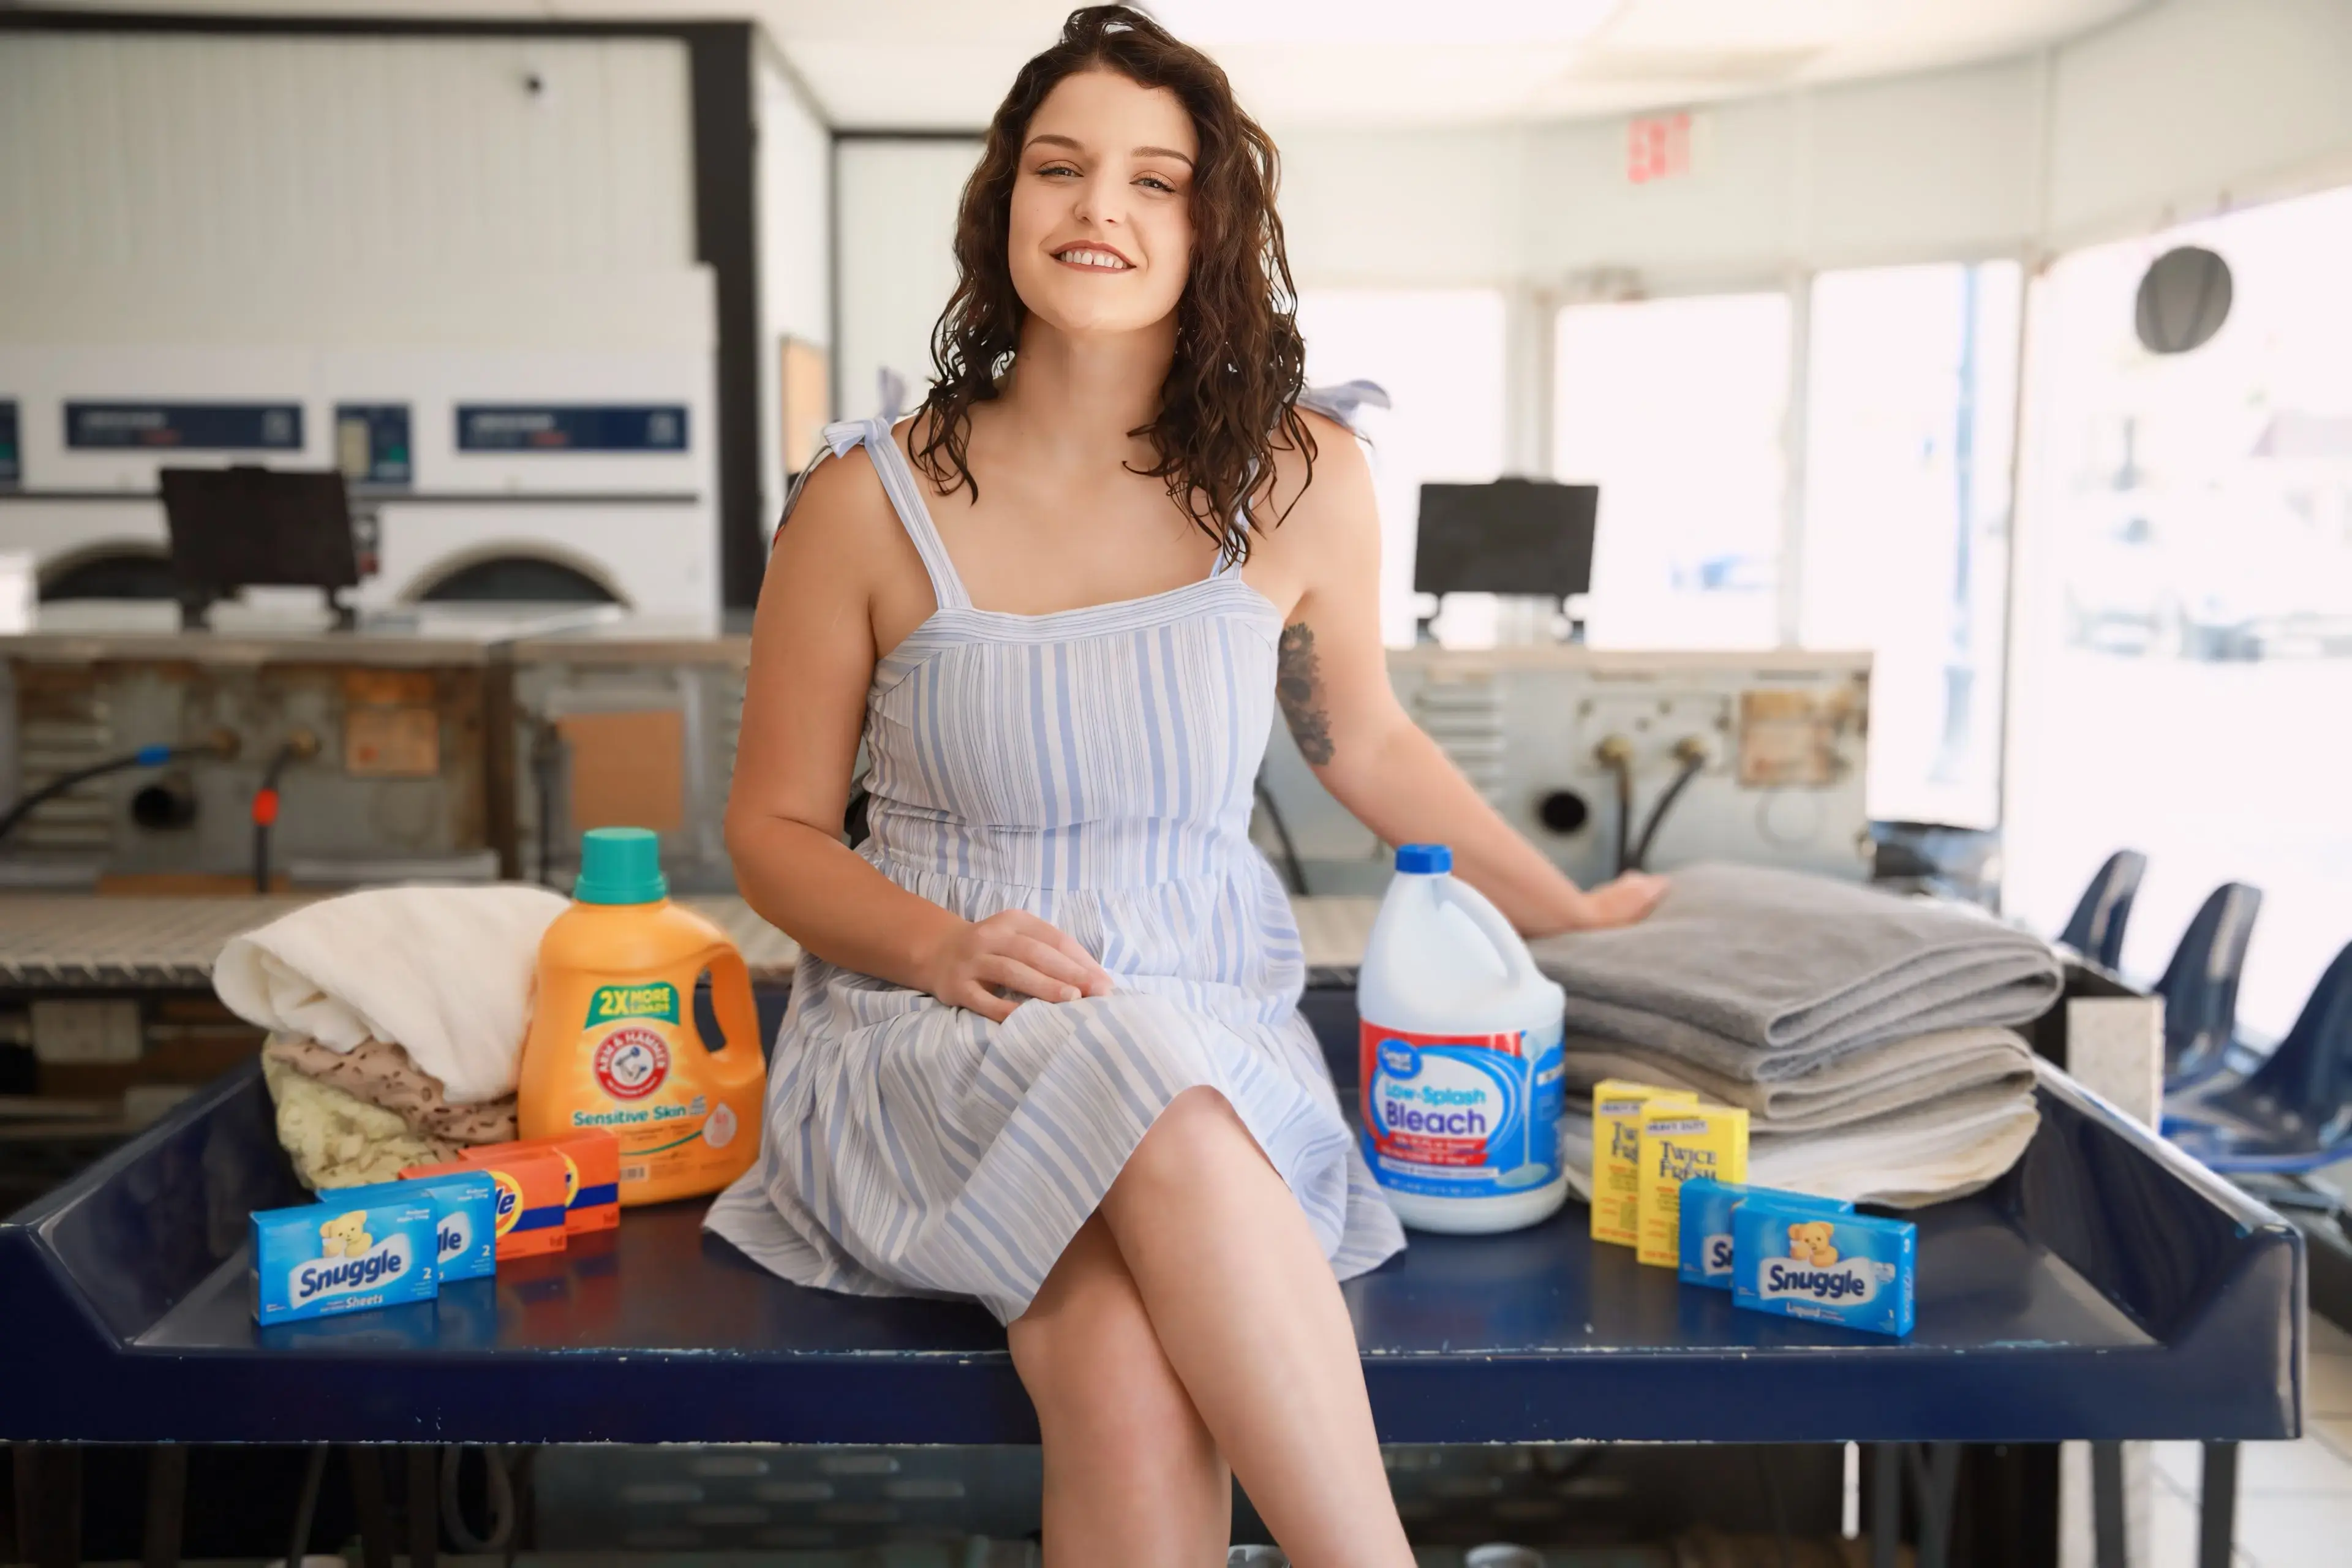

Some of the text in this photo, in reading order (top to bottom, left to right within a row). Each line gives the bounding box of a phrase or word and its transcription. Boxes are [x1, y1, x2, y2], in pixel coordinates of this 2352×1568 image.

[599, 989, 630, 1016] 2X
[630, 987, 670, 1004] MORE
[573, 1110, 649, 1126] Sensitive
[653, 1104, 687, 1120] Skin
[1385, 1099, 1487, 1135] Bleach
[1659, 1140, 1717, 1165] TWICE
[481, 1245, 491, 1256] 2
[300, 1248, 401, 1297] Snuggle
[423, 1267, 432, 1280] 2
[1767, 1265, 1865, 1299] Snuggle
[346, 1294, 383, 1308] Sheets
